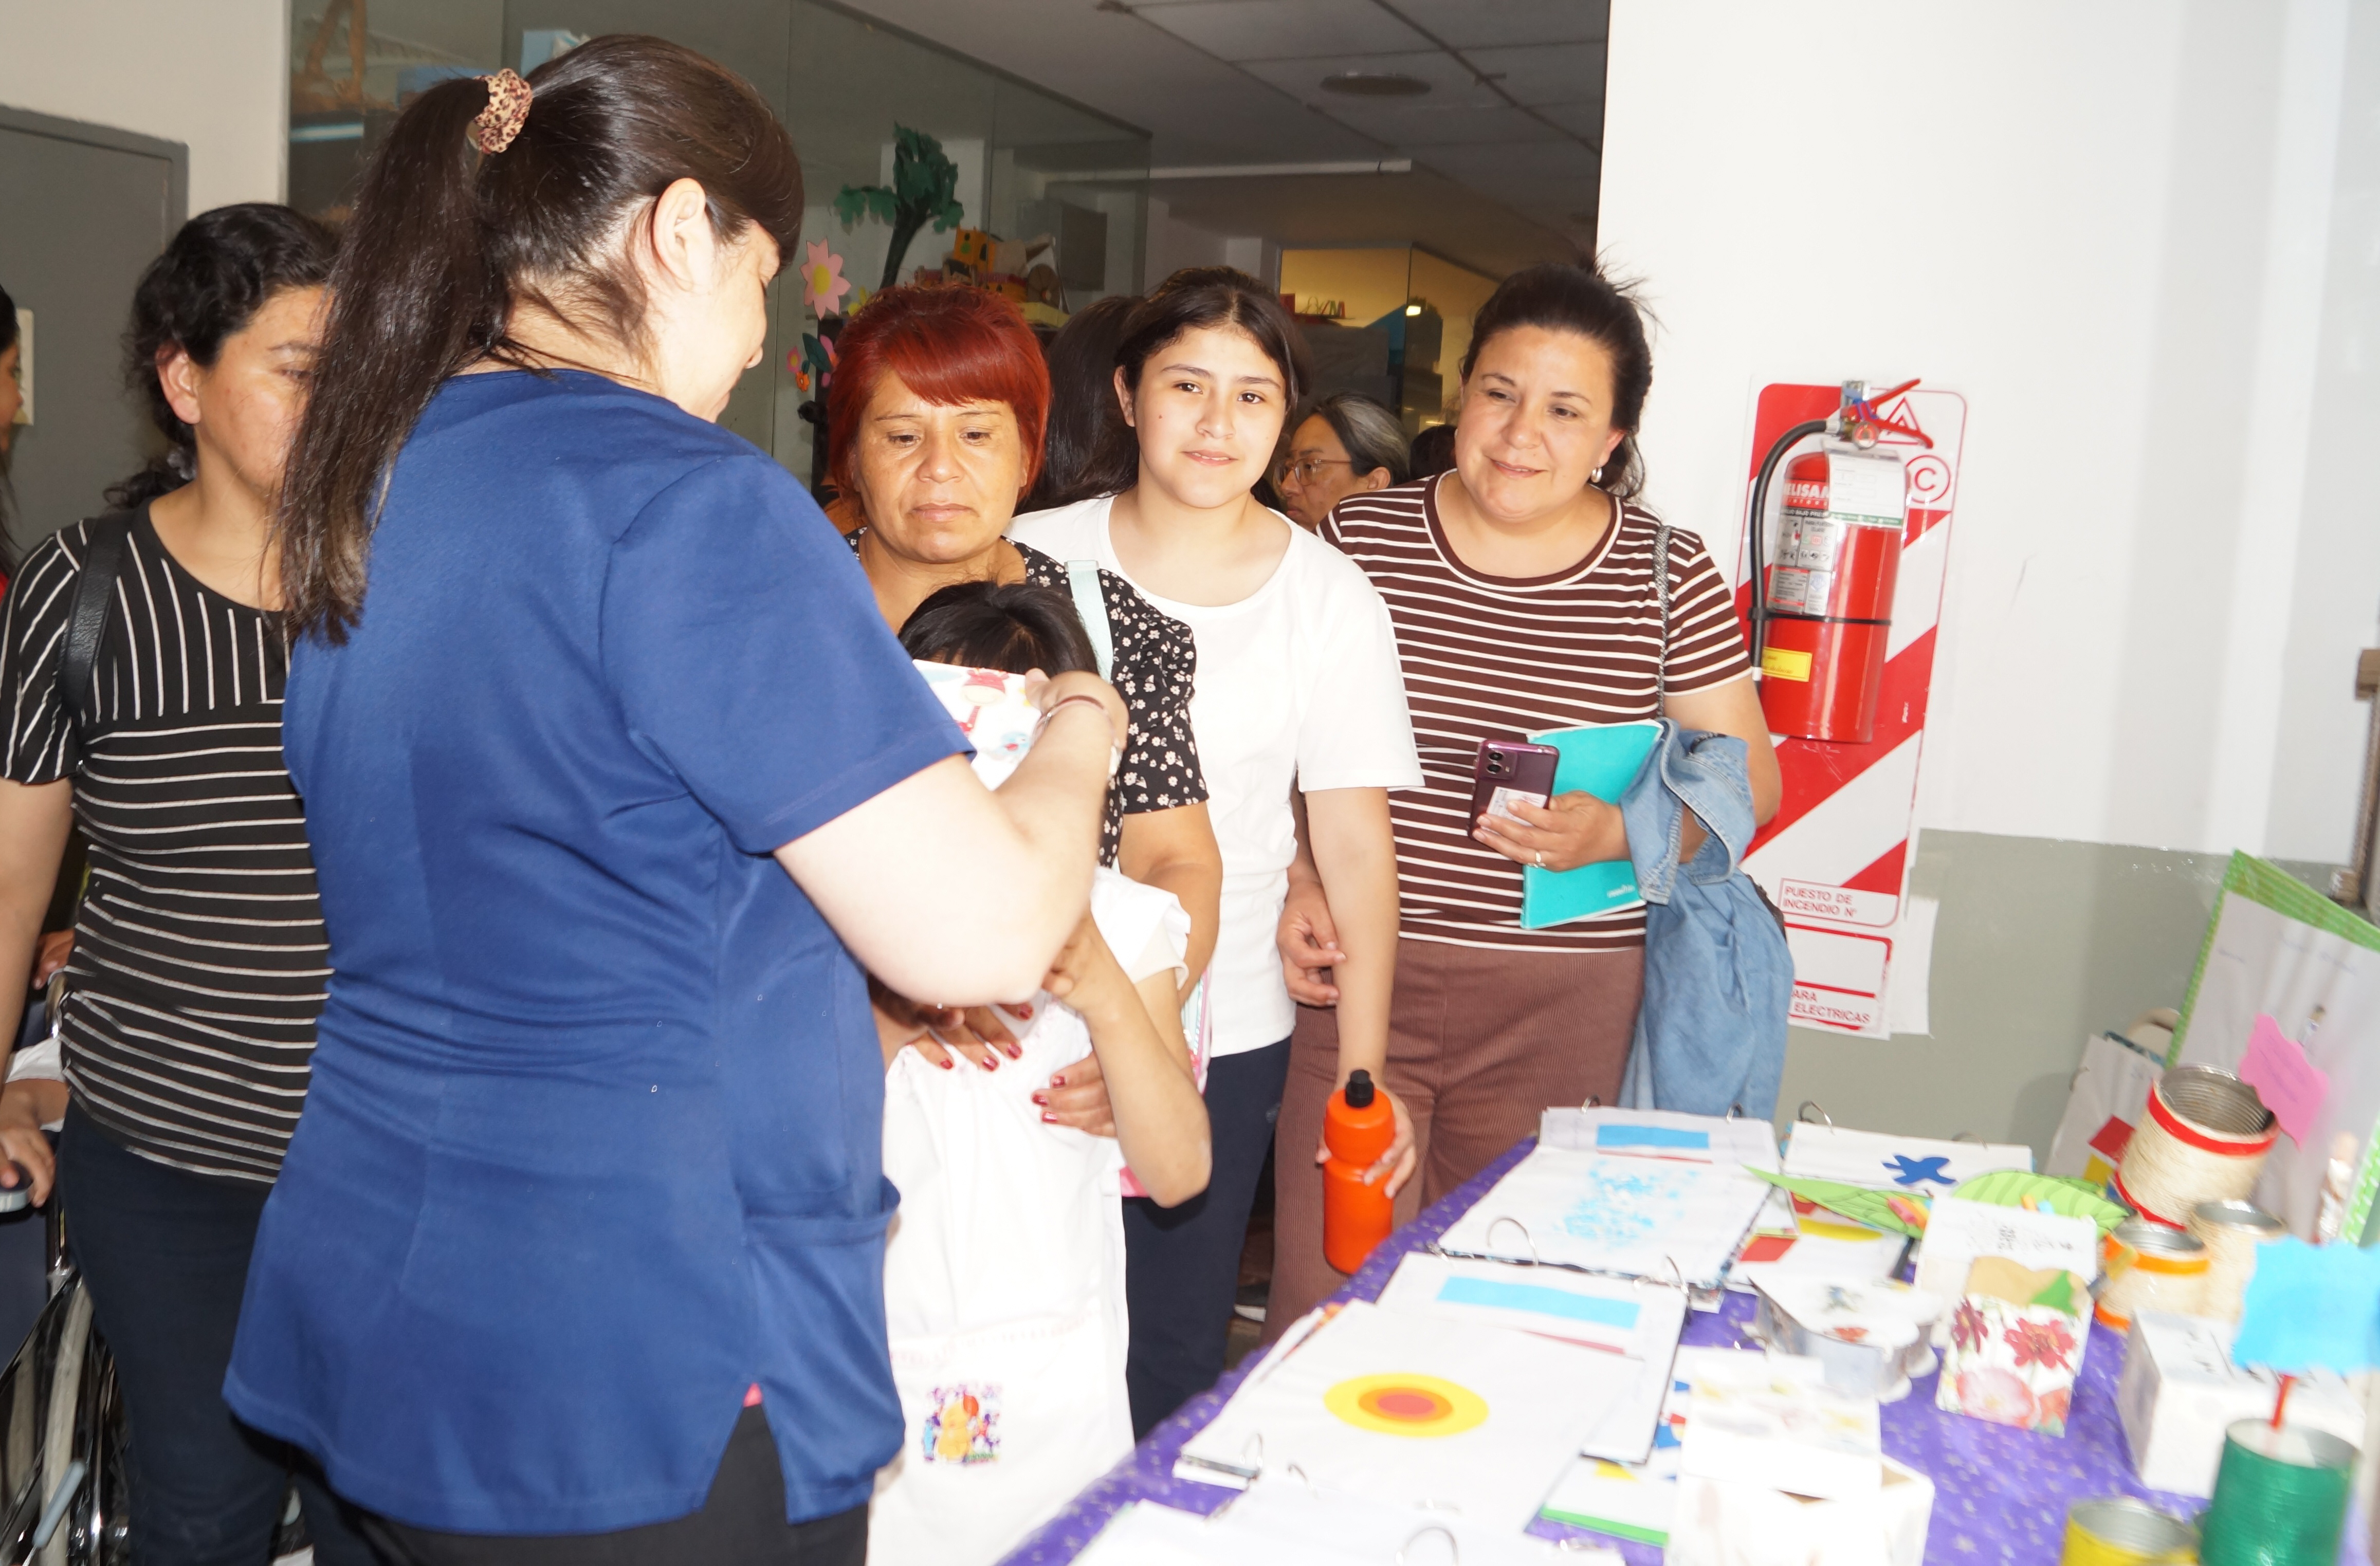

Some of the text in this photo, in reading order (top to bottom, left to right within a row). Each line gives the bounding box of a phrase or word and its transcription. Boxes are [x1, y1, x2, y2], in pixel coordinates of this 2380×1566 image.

[1914, 467, 1936, 491] C
[1785, 886, 1853, 905] PUESTO DE
[1784, 898, 1839, 915] INCENDIO
[1791, 990, 1817, 1002] ARA
[1794, 1003, 1870, 1023] ELECTRICAS
